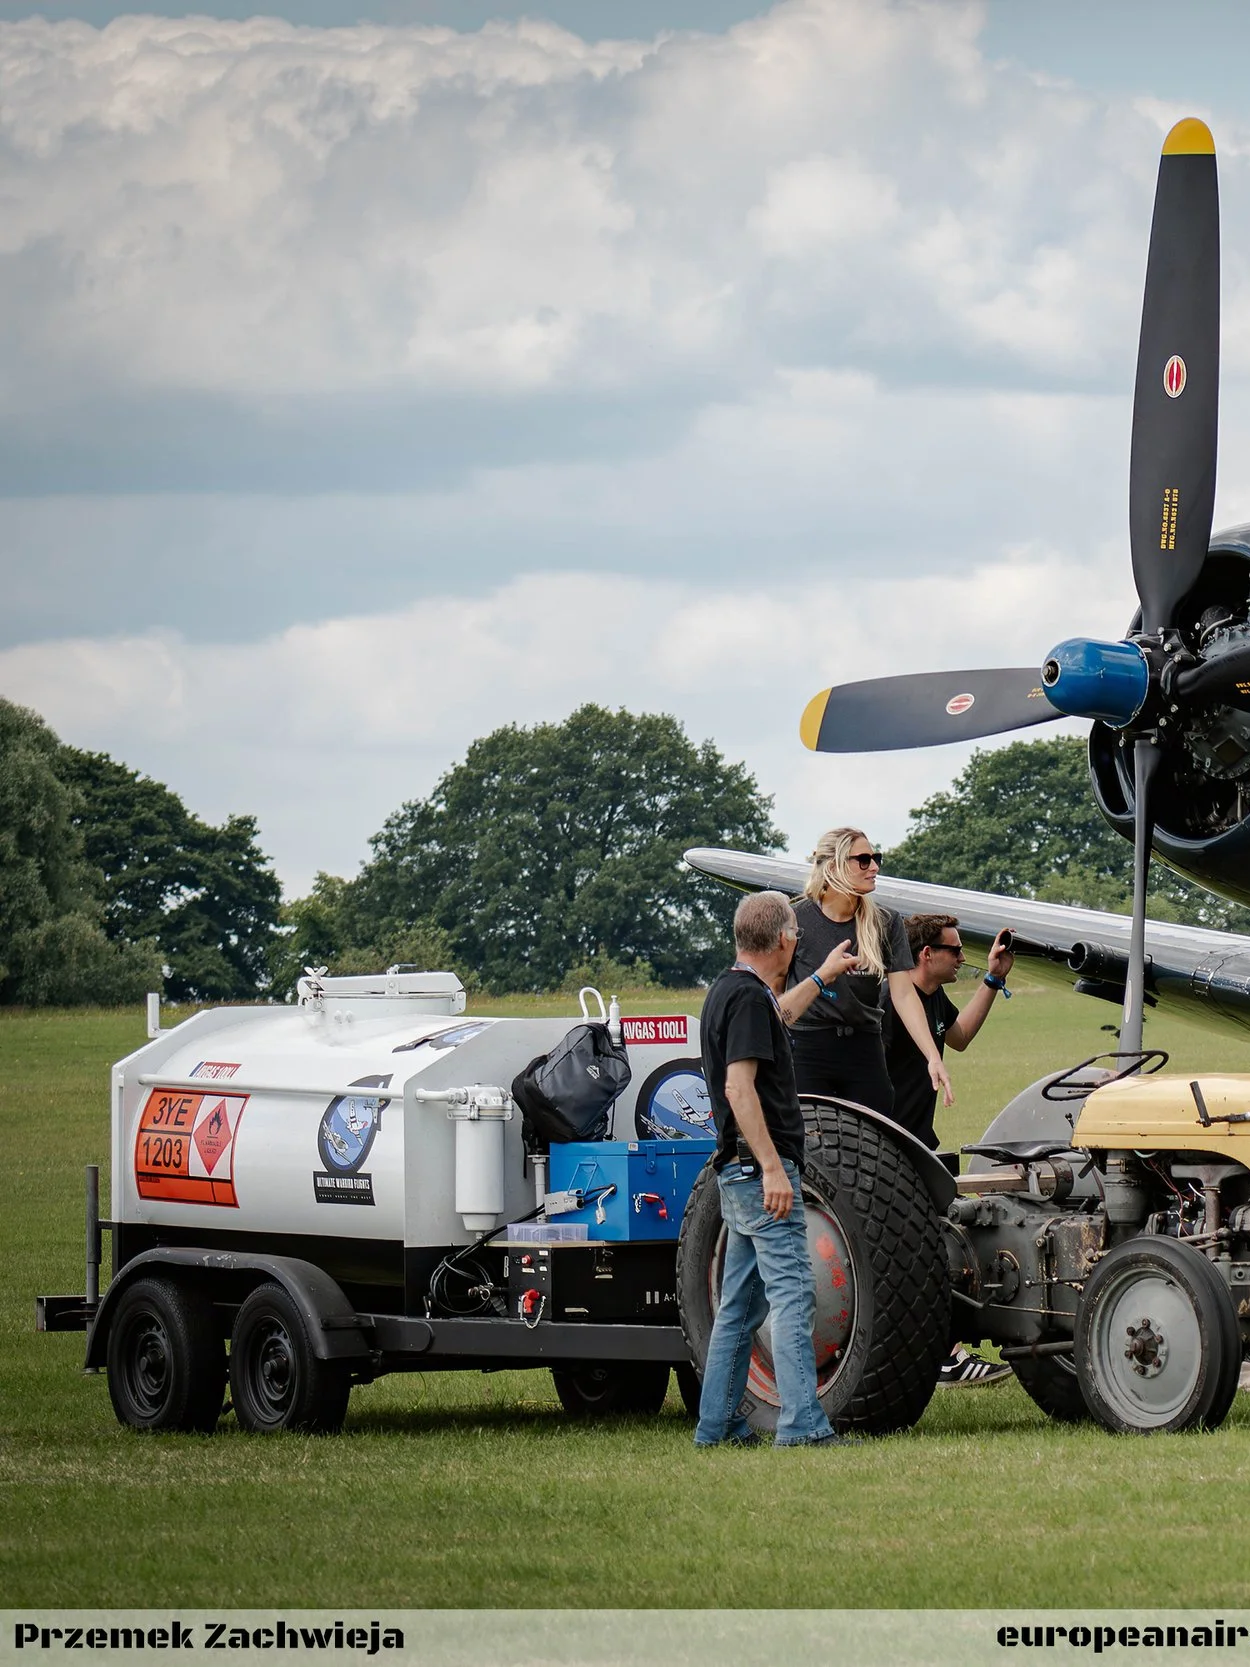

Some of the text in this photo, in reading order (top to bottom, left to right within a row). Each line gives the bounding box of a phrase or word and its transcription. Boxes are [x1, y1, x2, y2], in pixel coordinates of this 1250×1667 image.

[623, 1020, 687, 1040] AVGAS 100LL
[152, 1097, 193, 1126] 3YE
[142, 1137, 182, 1168] 1203
